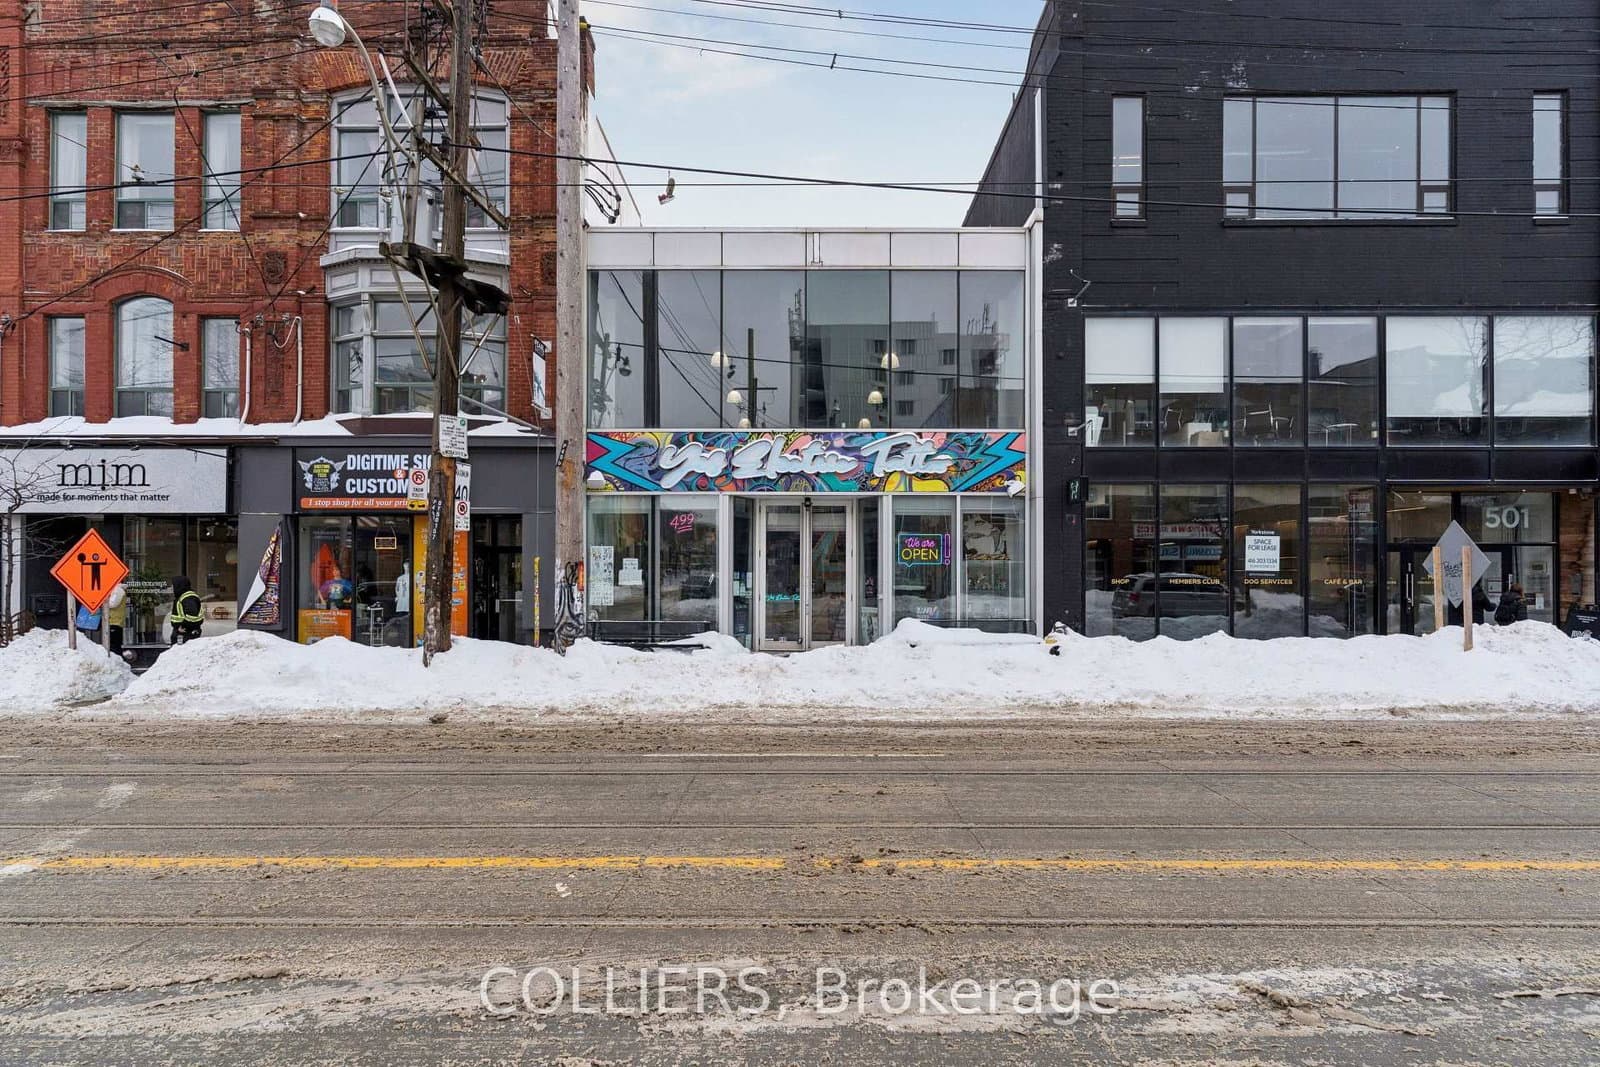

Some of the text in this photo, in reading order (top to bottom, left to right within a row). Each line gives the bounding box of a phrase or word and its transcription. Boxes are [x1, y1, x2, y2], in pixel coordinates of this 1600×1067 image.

[347, 454, 409, 471] DIGITIME
[346, 478, 409, 494] CUSTOM
[37, 493, 170, 501] made for moments that matter
[315, 499, 331, 507] stop
[332, 499, 350, 508] shop
[351, 499, 362, 507] for
[376, 500, 393, 508] your
[670, 513, 694, 529] 499
[1485, 507, 1529, 528] 501
[905, 537, 936, 548] We are
[901, 548, 939, 560] OPEN
